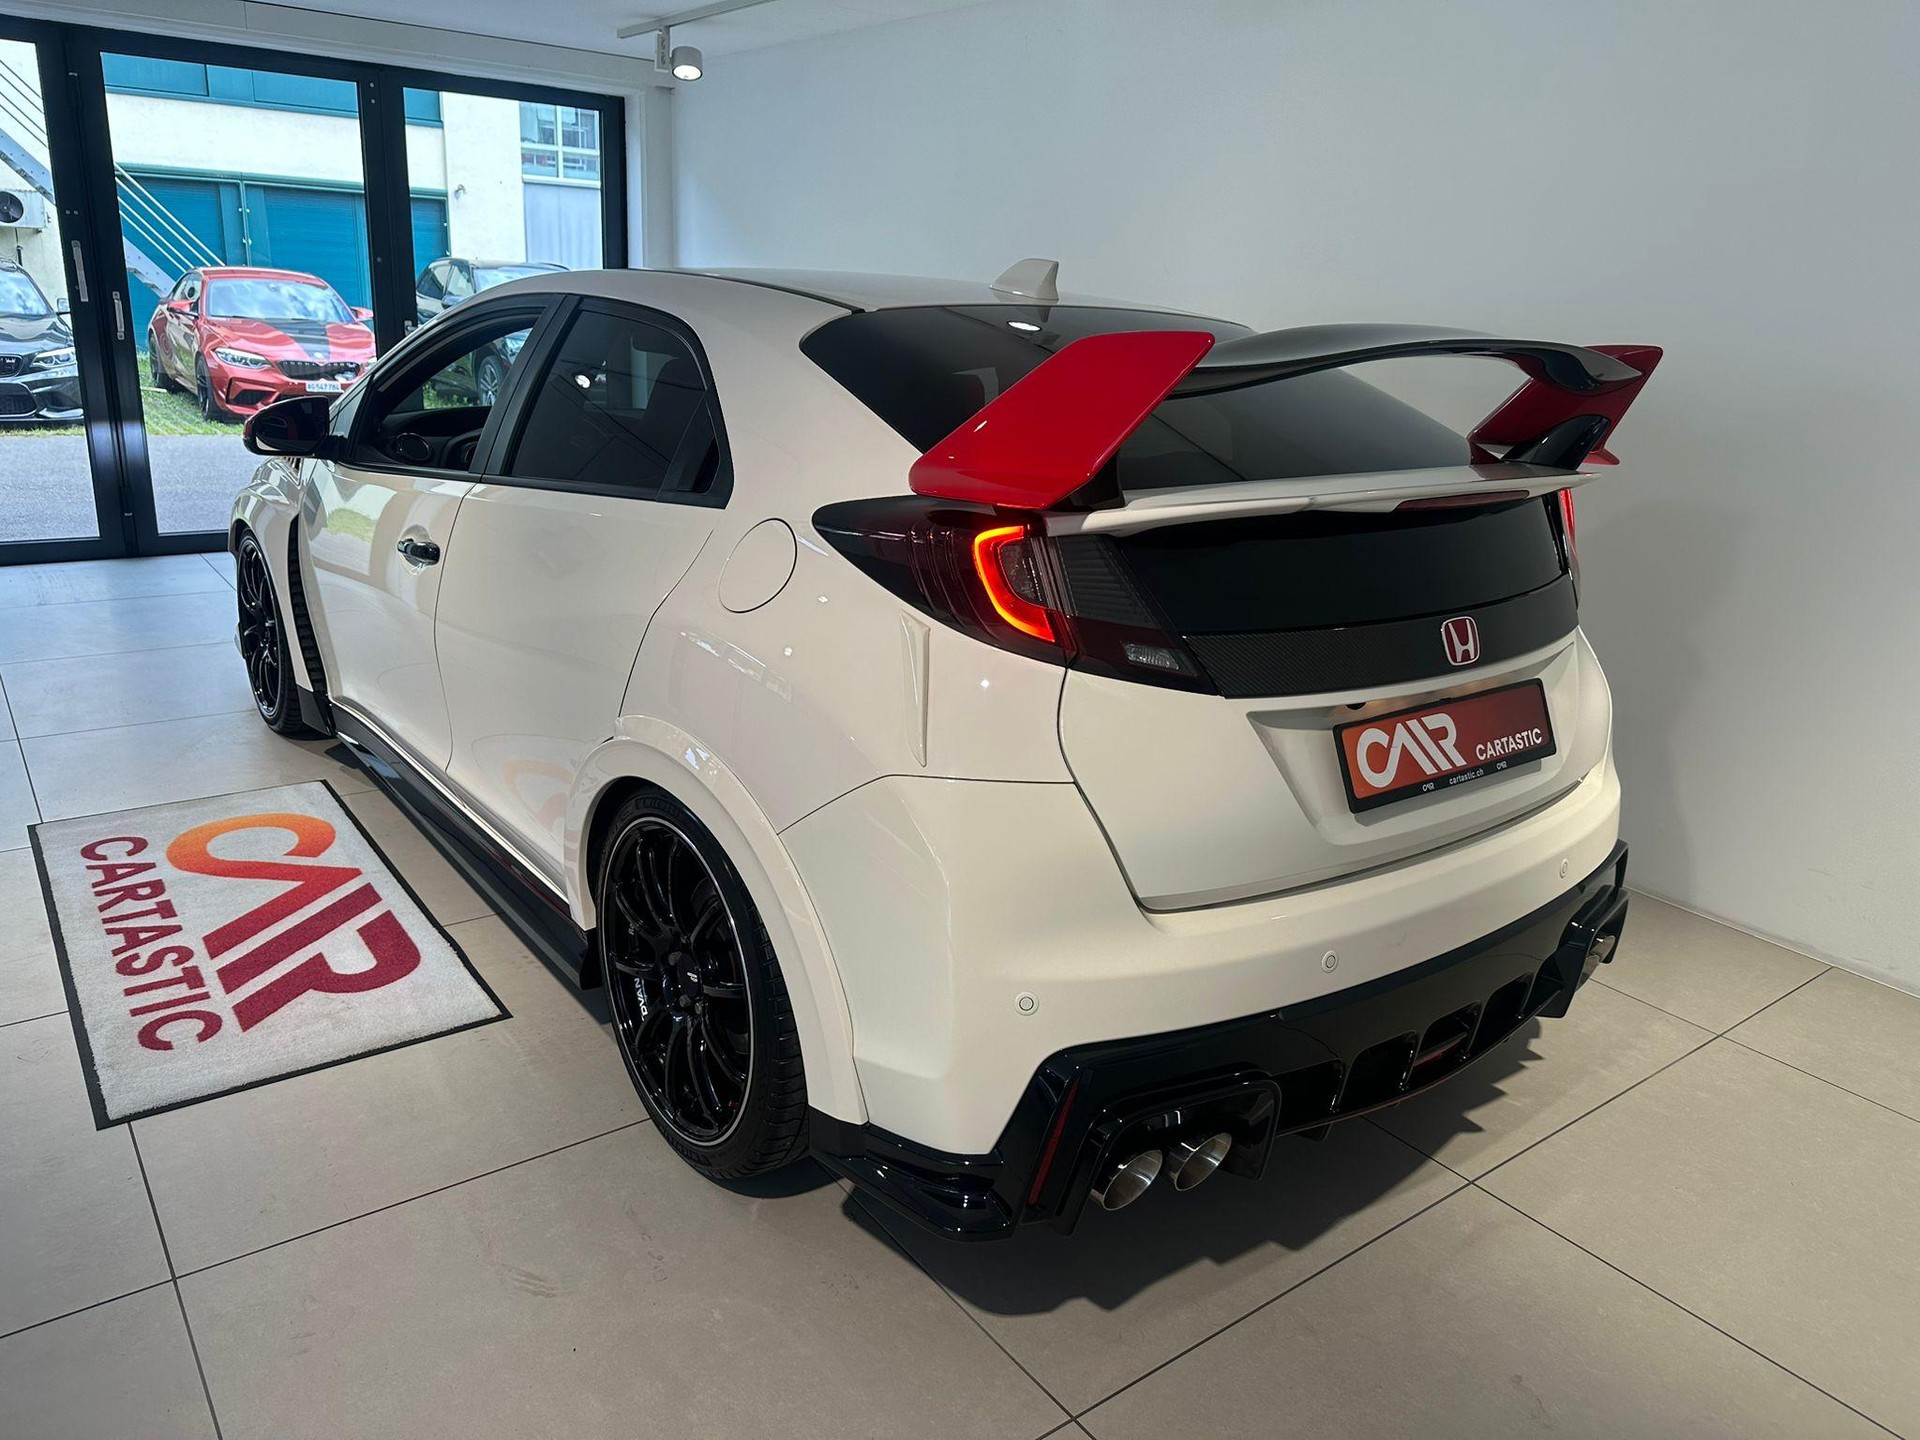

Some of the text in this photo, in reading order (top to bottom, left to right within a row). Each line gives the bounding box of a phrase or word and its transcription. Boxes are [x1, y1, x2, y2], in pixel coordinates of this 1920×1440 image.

[1475, 728, 1542, 761] CARTASTIC
[1449, 768, 1484, 785] cartastic.ch
[80, 836, 223, 1051] CARTASTIC
